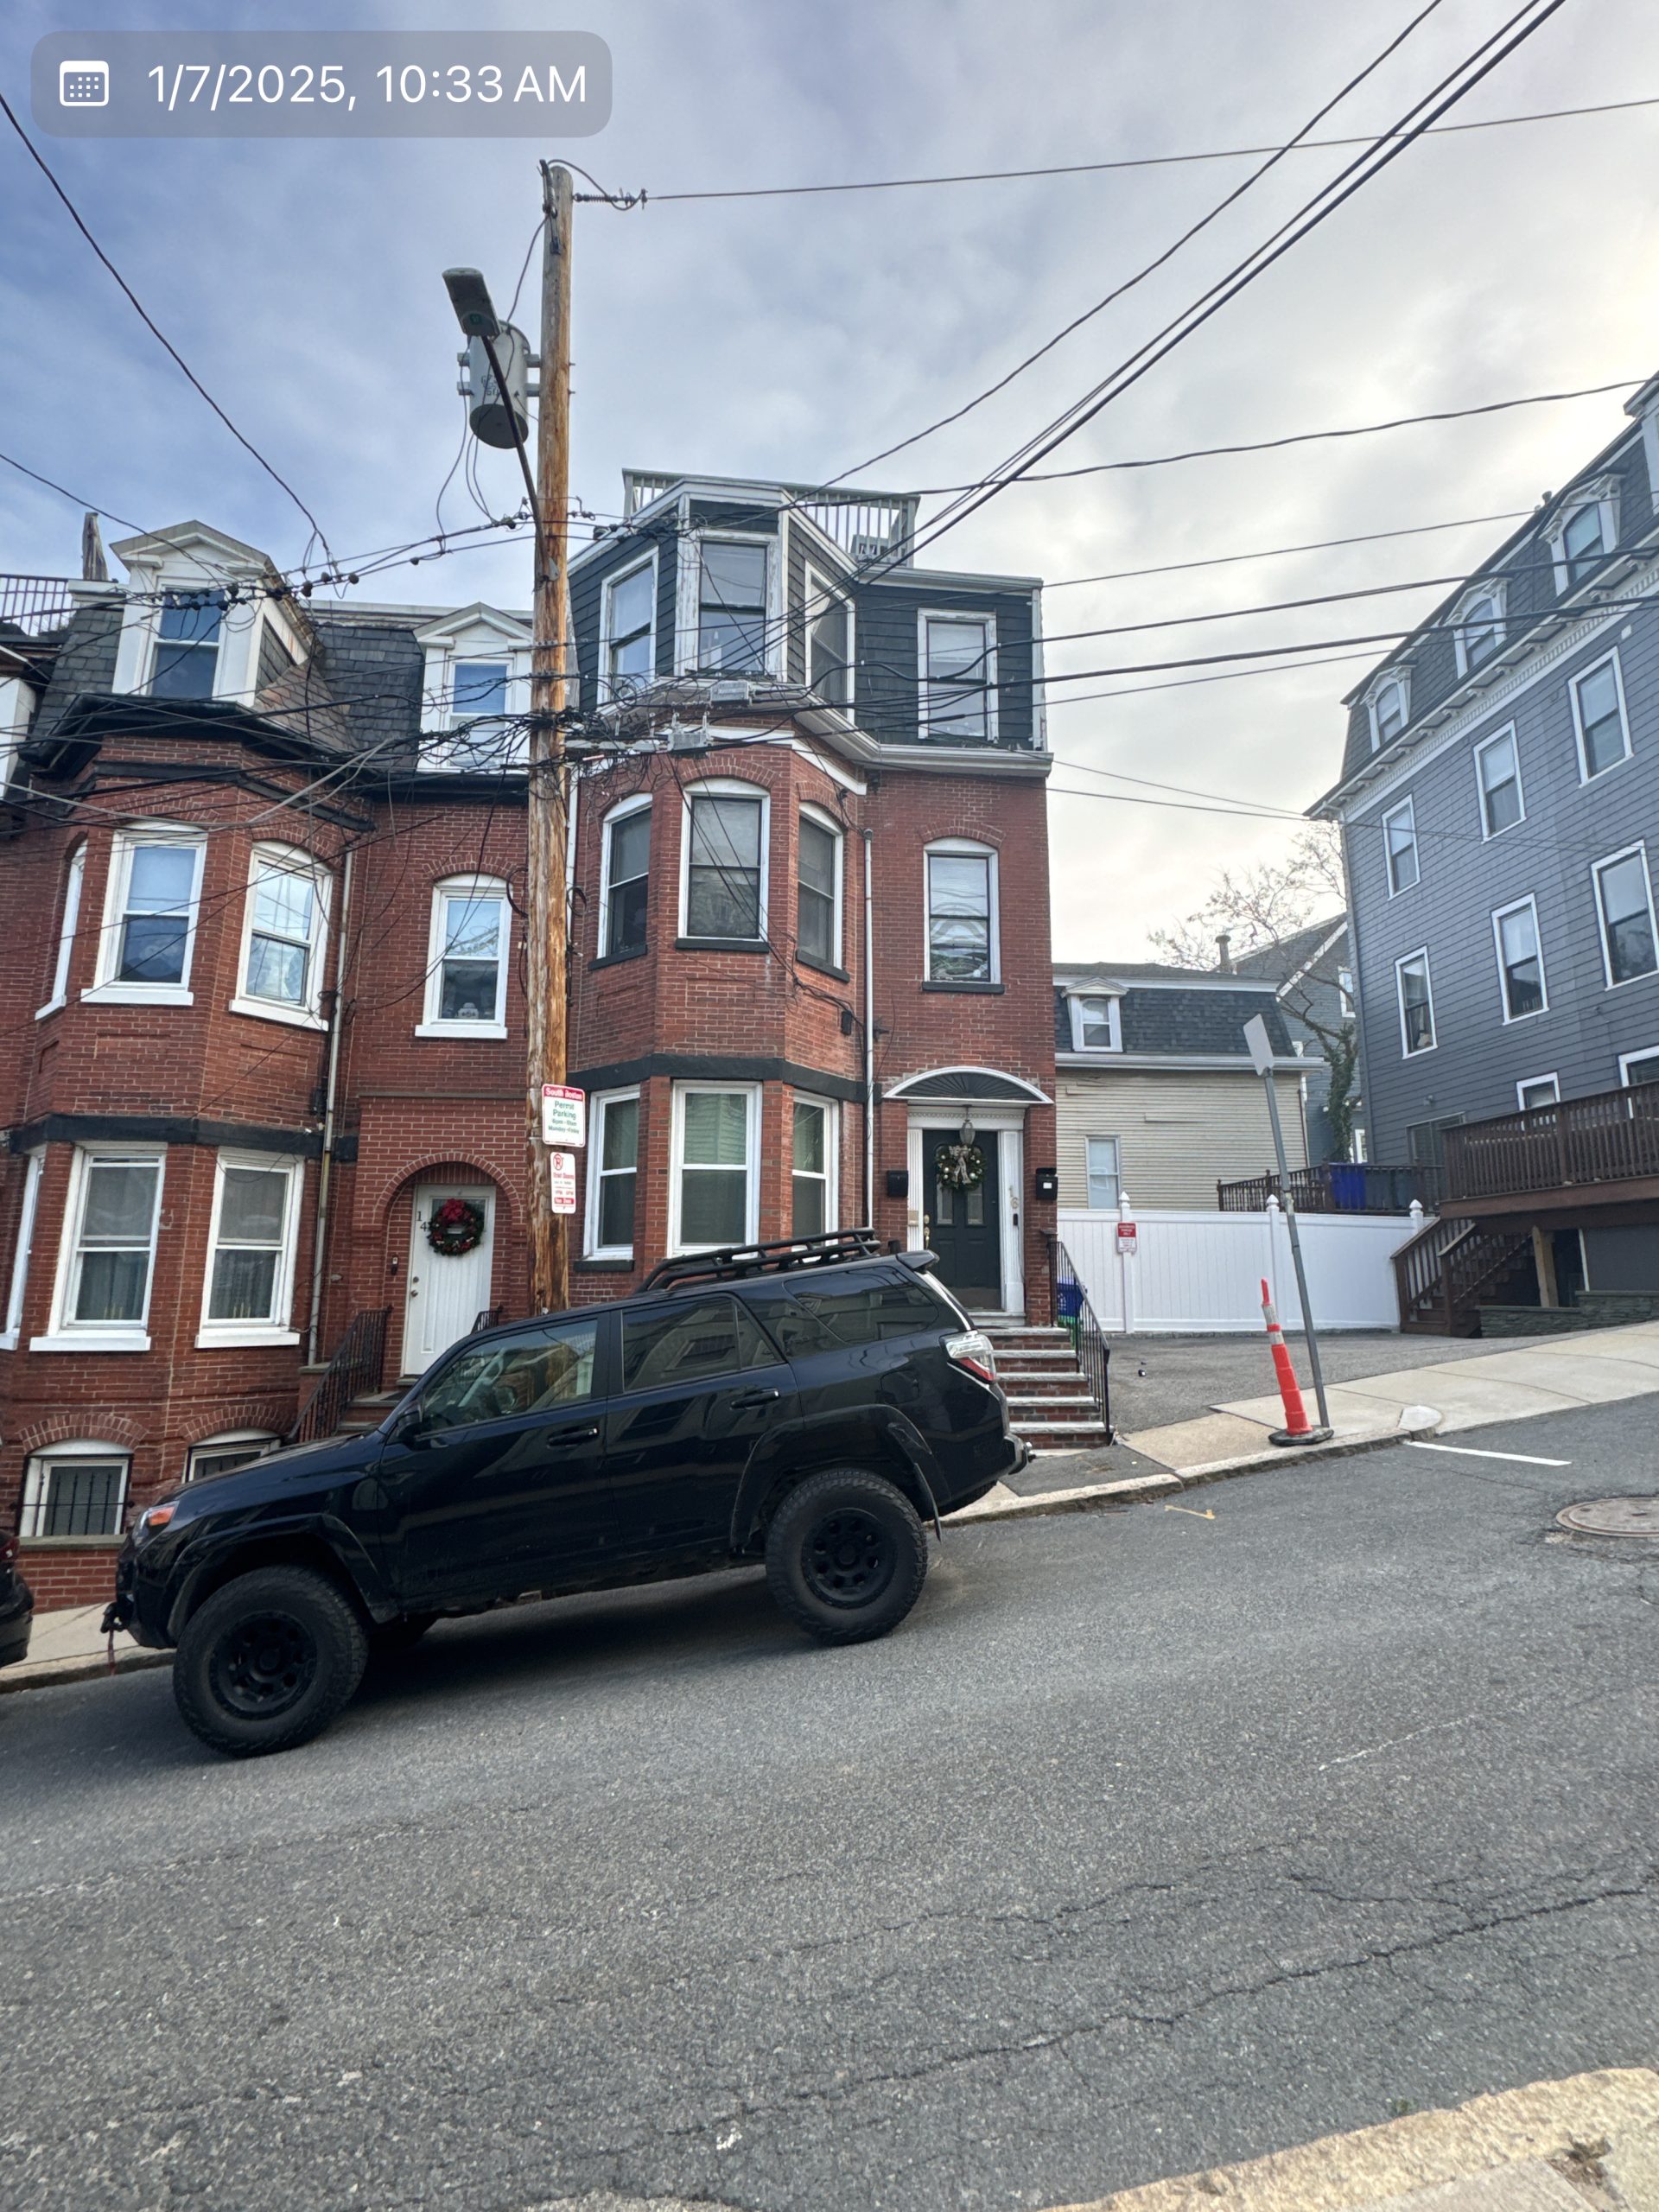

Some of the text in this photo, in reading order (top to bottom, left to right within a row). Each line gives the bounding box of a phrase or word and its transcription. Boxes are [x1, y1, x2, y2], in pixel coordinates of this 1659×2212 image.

[545, 1087, 564, 1097] South
[554, 1100, 575, 1110] Permit
[552, 1109, 576, 1121] Parking
